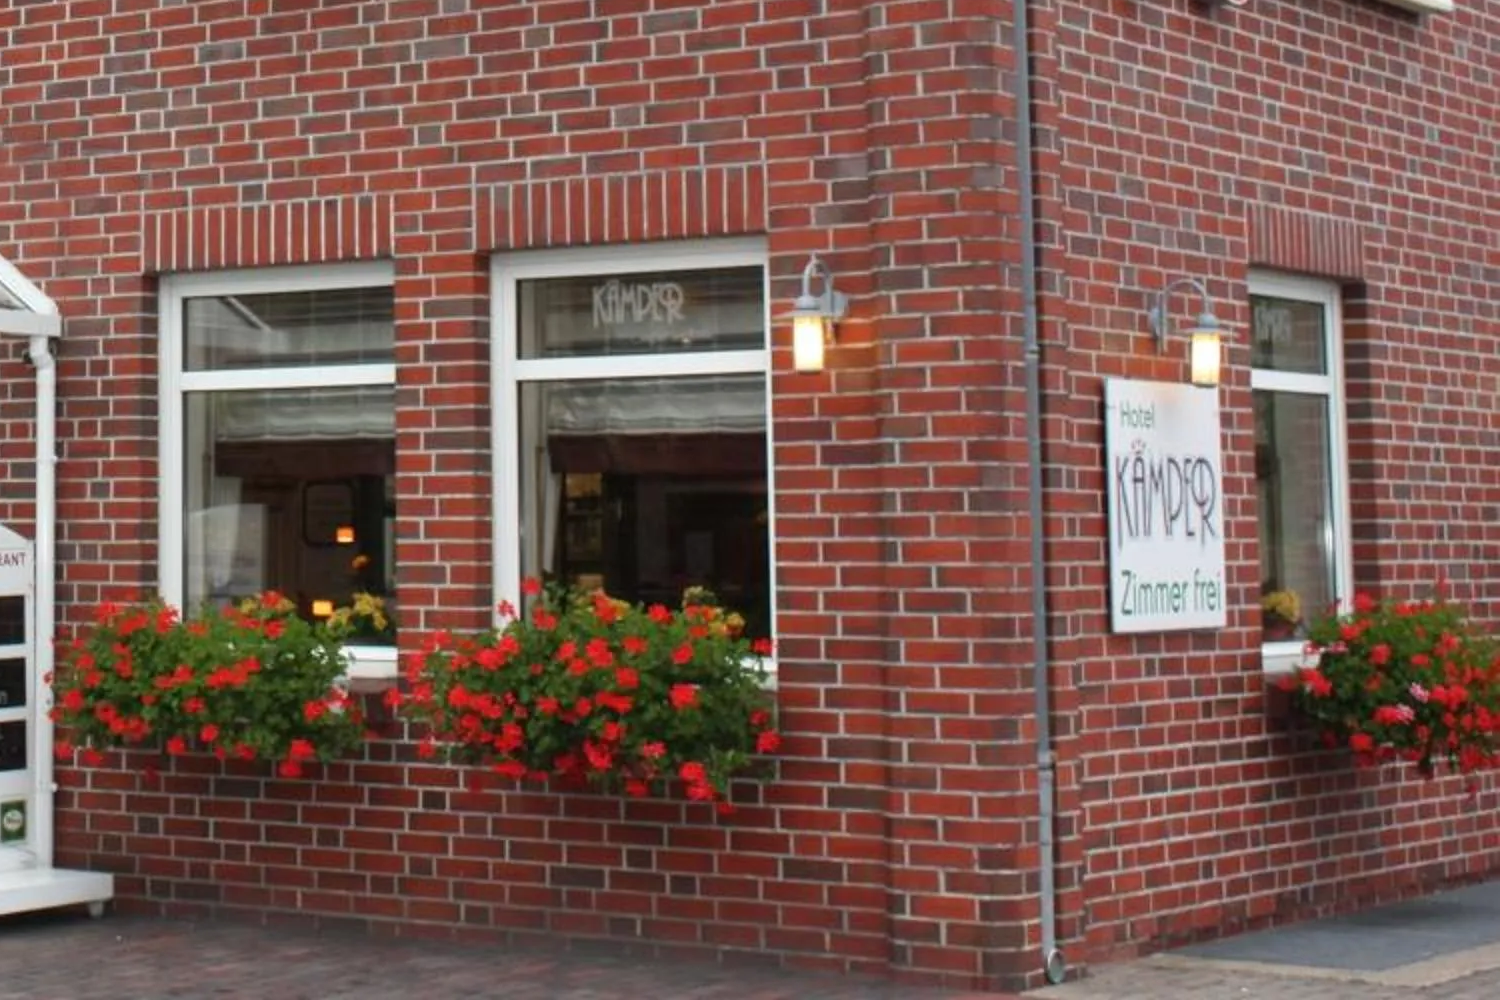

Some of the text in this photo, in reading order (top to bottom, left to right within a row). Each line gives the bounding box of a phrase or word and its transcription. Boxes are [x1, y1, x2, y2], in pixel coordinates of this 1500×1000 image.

[1120, 402, 1155, 429] Hotel
[1120, 568, 1222, 616] Zimmer frei
